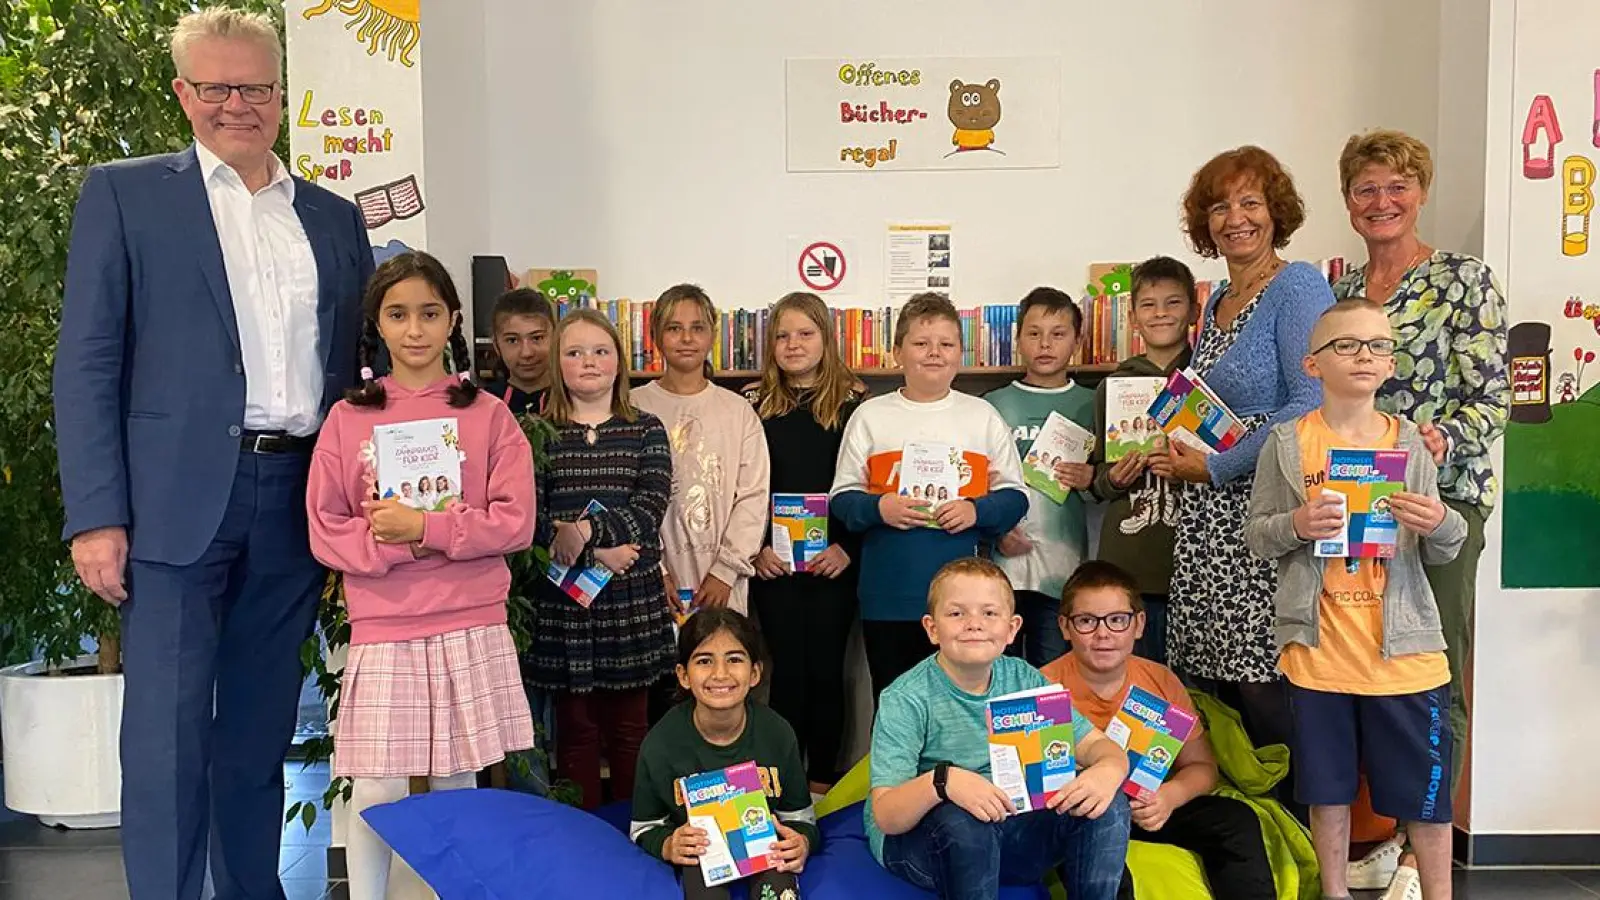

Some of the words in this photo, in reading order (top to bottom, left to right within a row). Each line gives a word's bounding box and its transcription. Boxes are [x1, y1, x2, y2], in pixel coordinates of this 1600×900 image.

[838, 63, 921, 87] Offenes
[297, 90, 383, 127] Lesen
[840, 101, 928, 124] Bücher-
[324, 128, 394, 154] macht
[840, 139, 898, 168] regal
[297, 154, 353, 184] Spaß
